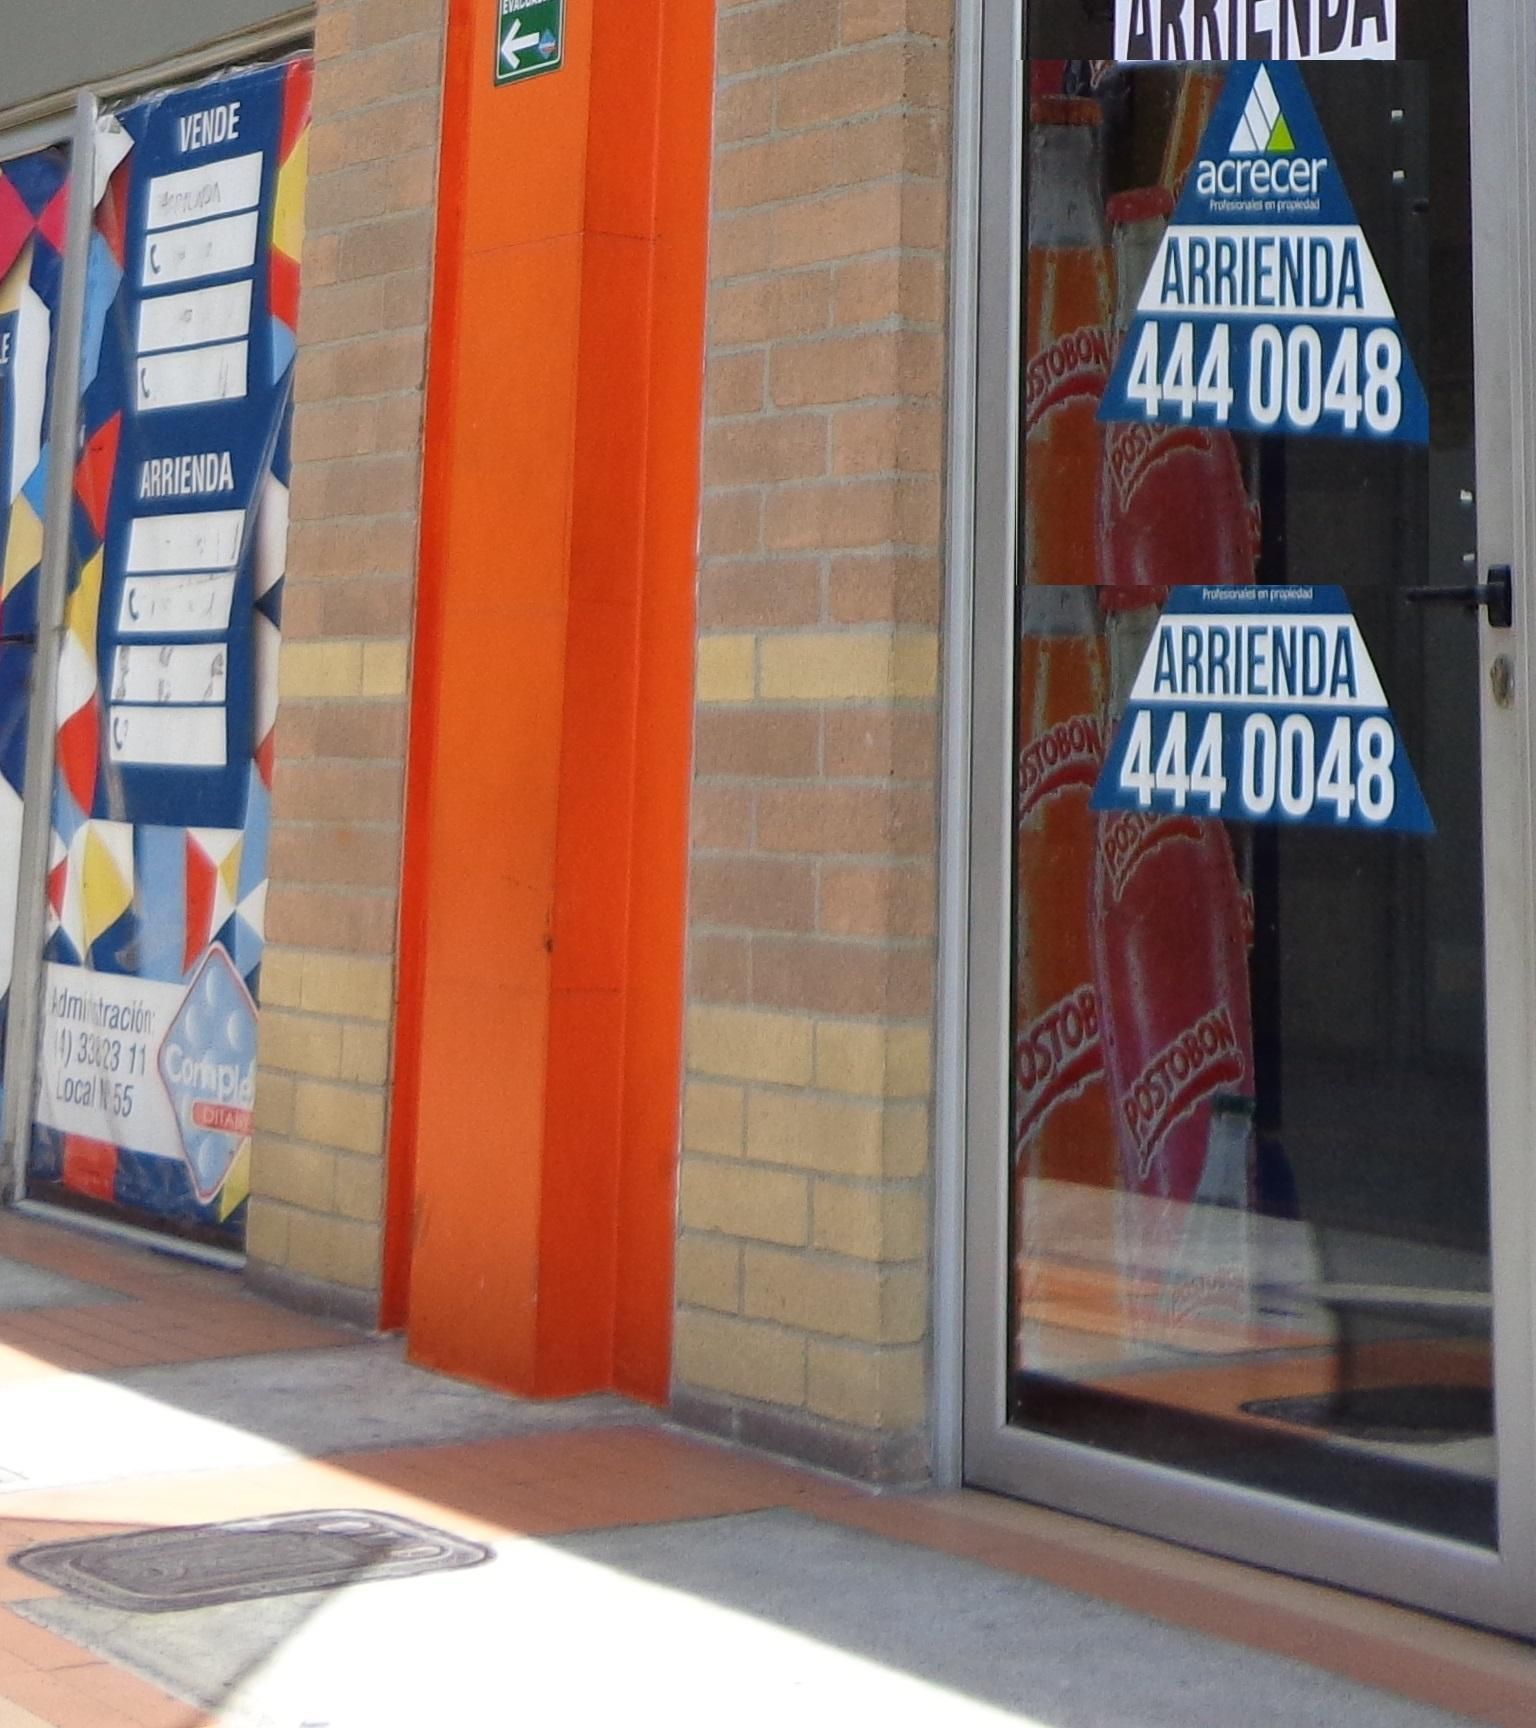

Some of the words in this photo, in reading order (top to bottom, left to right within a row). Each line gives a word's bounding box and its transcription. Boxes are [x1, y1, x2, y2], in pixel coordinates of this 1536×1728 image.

[180, 101, 241, 153] VENDE
[1196, 157, 1328, 195] acrecer
[1209, 199, 1263, 212] Profesionales
[1264, 201, 1276, 211] en
[1277, 198, 1321, 214] propiedad
[1160, 235, 1364, 309] ARRIENDA
[1126, 320, 1234, 422] 444
[1249, 323, 1402, 432] 0048
[139, 451, 235, 499] ARRIENDA
[1202, 588, 1256, 600] Profesionales
[1257, 590, 1269, 599] en
[1270, 587, 1313, 602] propiedad
[1153, 624, 1358, 699] ARRIENDA
[1120, 709, 1227, 810] 444
[1241, 712, 1395, 821] 0048
[56, 1073, 97, 1108] Local
